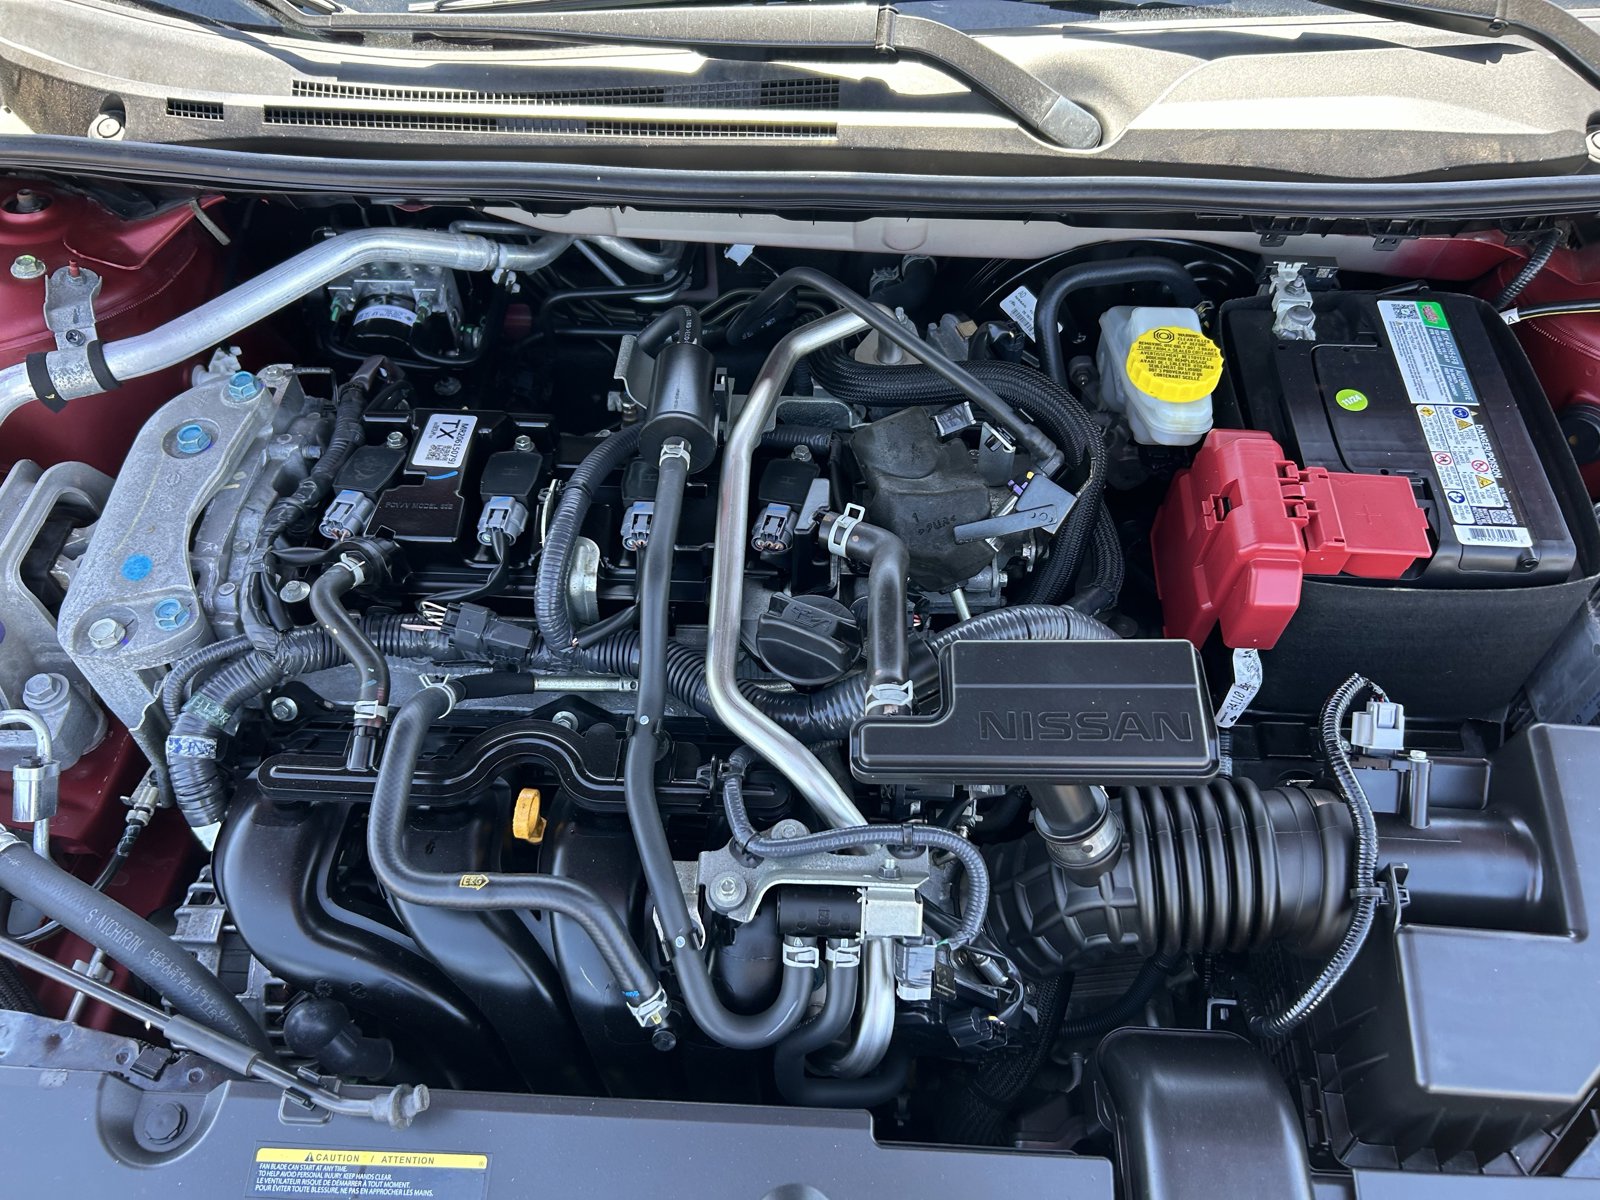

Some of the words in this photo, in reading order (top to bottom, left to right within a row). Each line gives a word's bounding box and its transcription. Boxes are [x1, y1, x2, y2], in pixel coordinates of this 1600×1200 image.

[436, 418, 462, 440] TX
[1475, 424, 1502, 478] DANGER/POISON
[978, 710, 1193, 742] NISSAN
[463, 876, 482, 885] EKG
[316, 1153, 360, 1162] CAUTION
[381, 1155, 434, 1164] ATTENTION
[332, 1178, 362, 1186] DÉMARRER
[272, 1184, 292, 1192] ÉVITER
